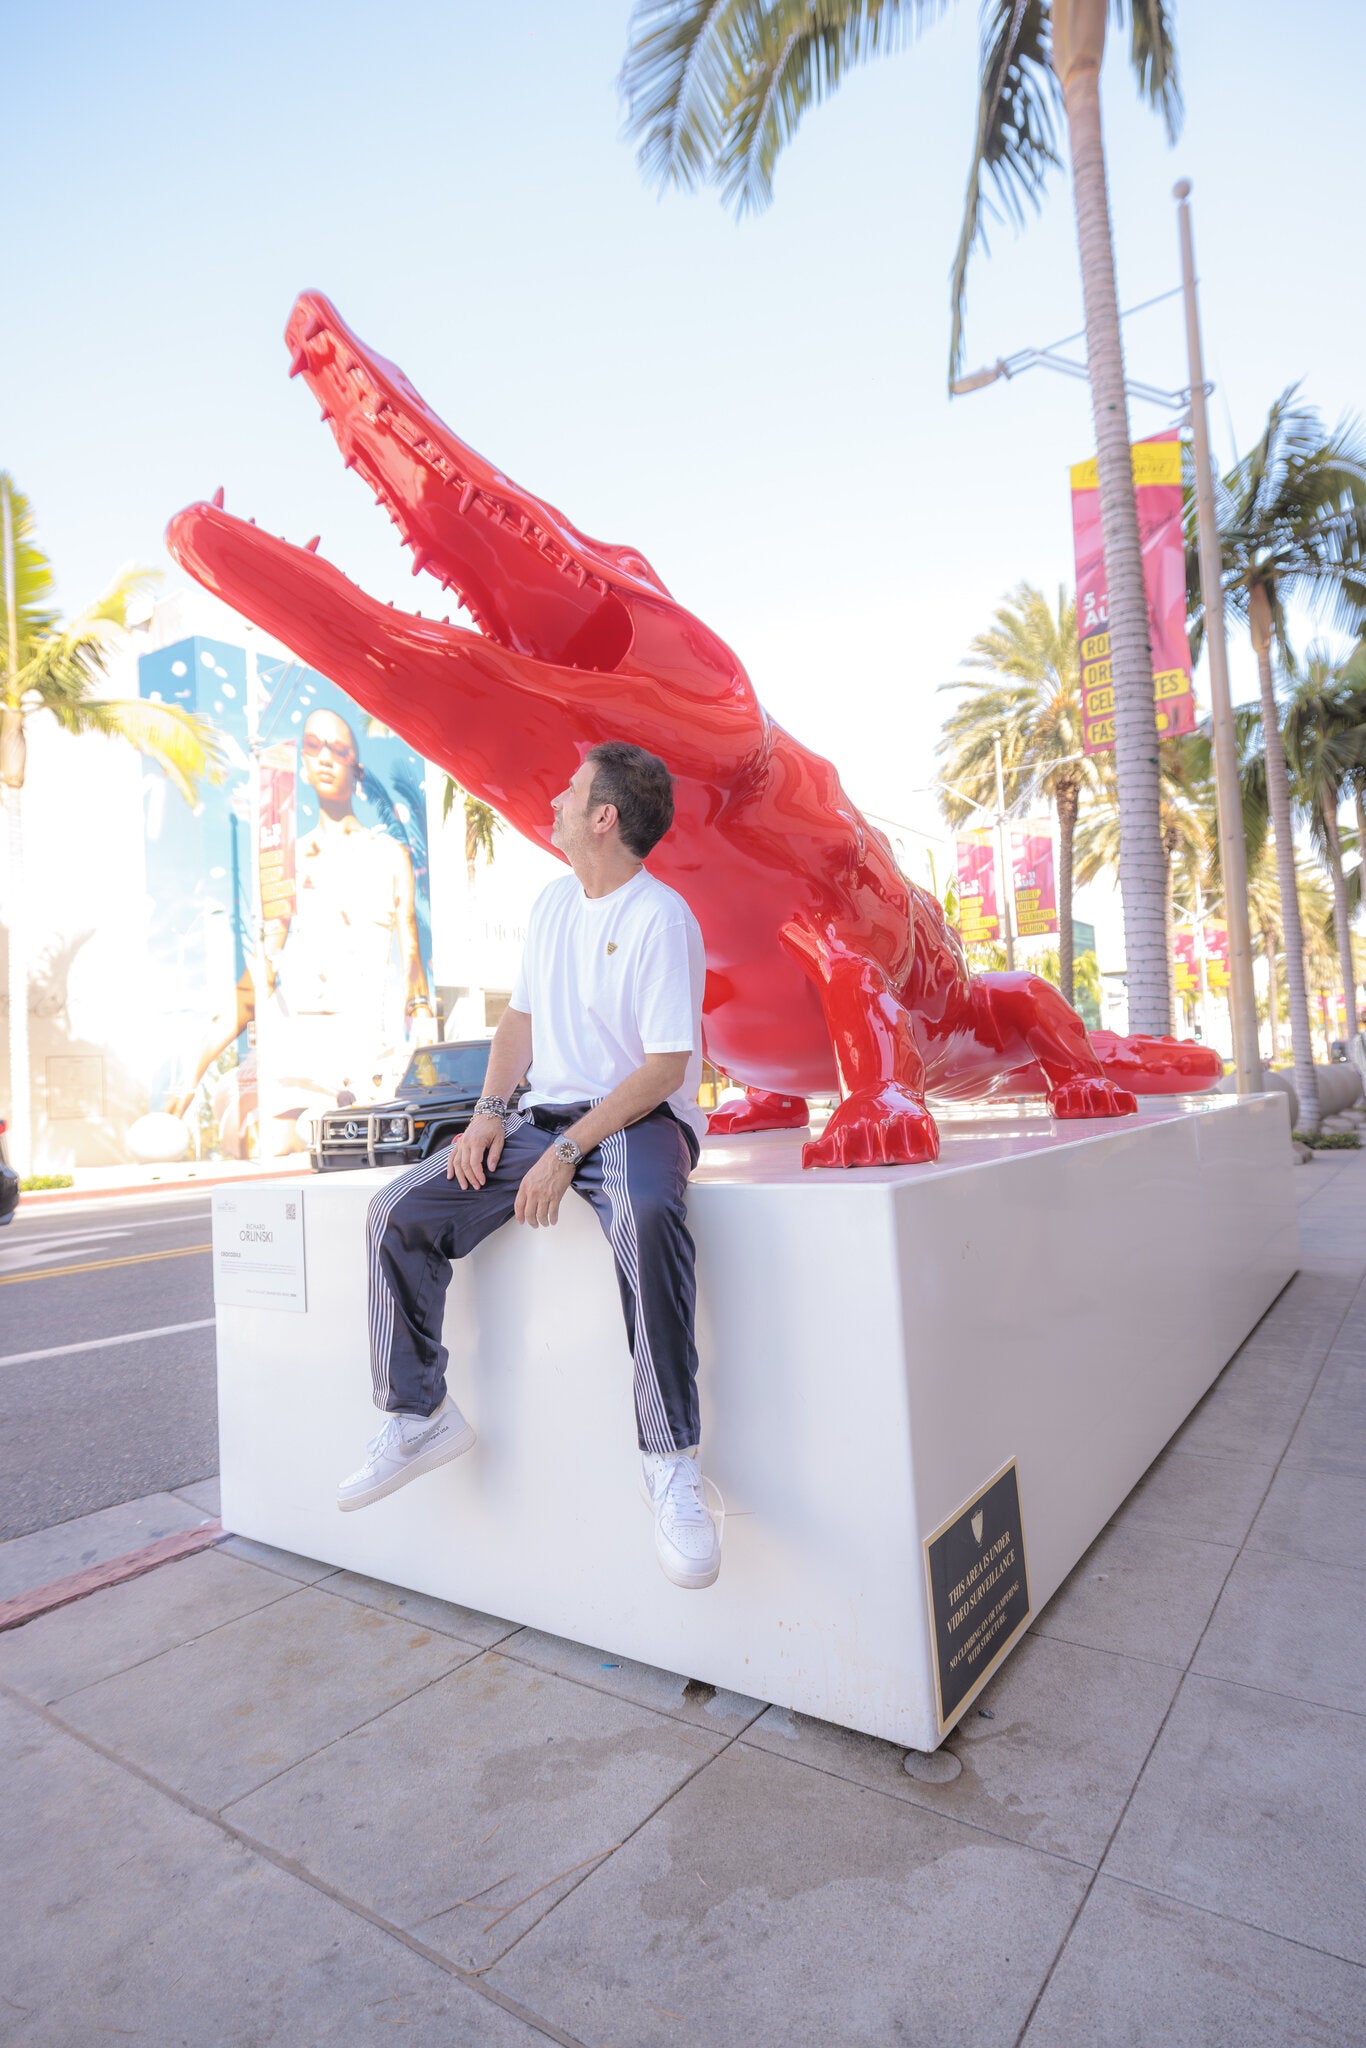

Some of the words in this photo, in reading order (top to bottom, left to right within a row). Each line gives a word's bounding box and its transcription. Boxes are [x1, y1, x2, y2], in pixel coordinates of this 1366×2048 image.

[239, 1230, 273, 1242] ORLINSKI
[947, 1601, 969, 1634] VIDEO
[970, 1548, 1016, 1610] SURVEILLANCE
[948, 1579, 966, 1607] THIS
[965, 1561, 983, 1588] AREA
[982, 1552, 990, 1568] IS
[989, 1530, 1011, 1560] UNDER
[949, 1655, 958, 1669] NO
[957, 1625, 981, 1661] CLIMBING
[981, 1618, 989, 1631] ON
[988, 1609, 996, 1623] OR
[967, 1642, 981, 1664] WITH
